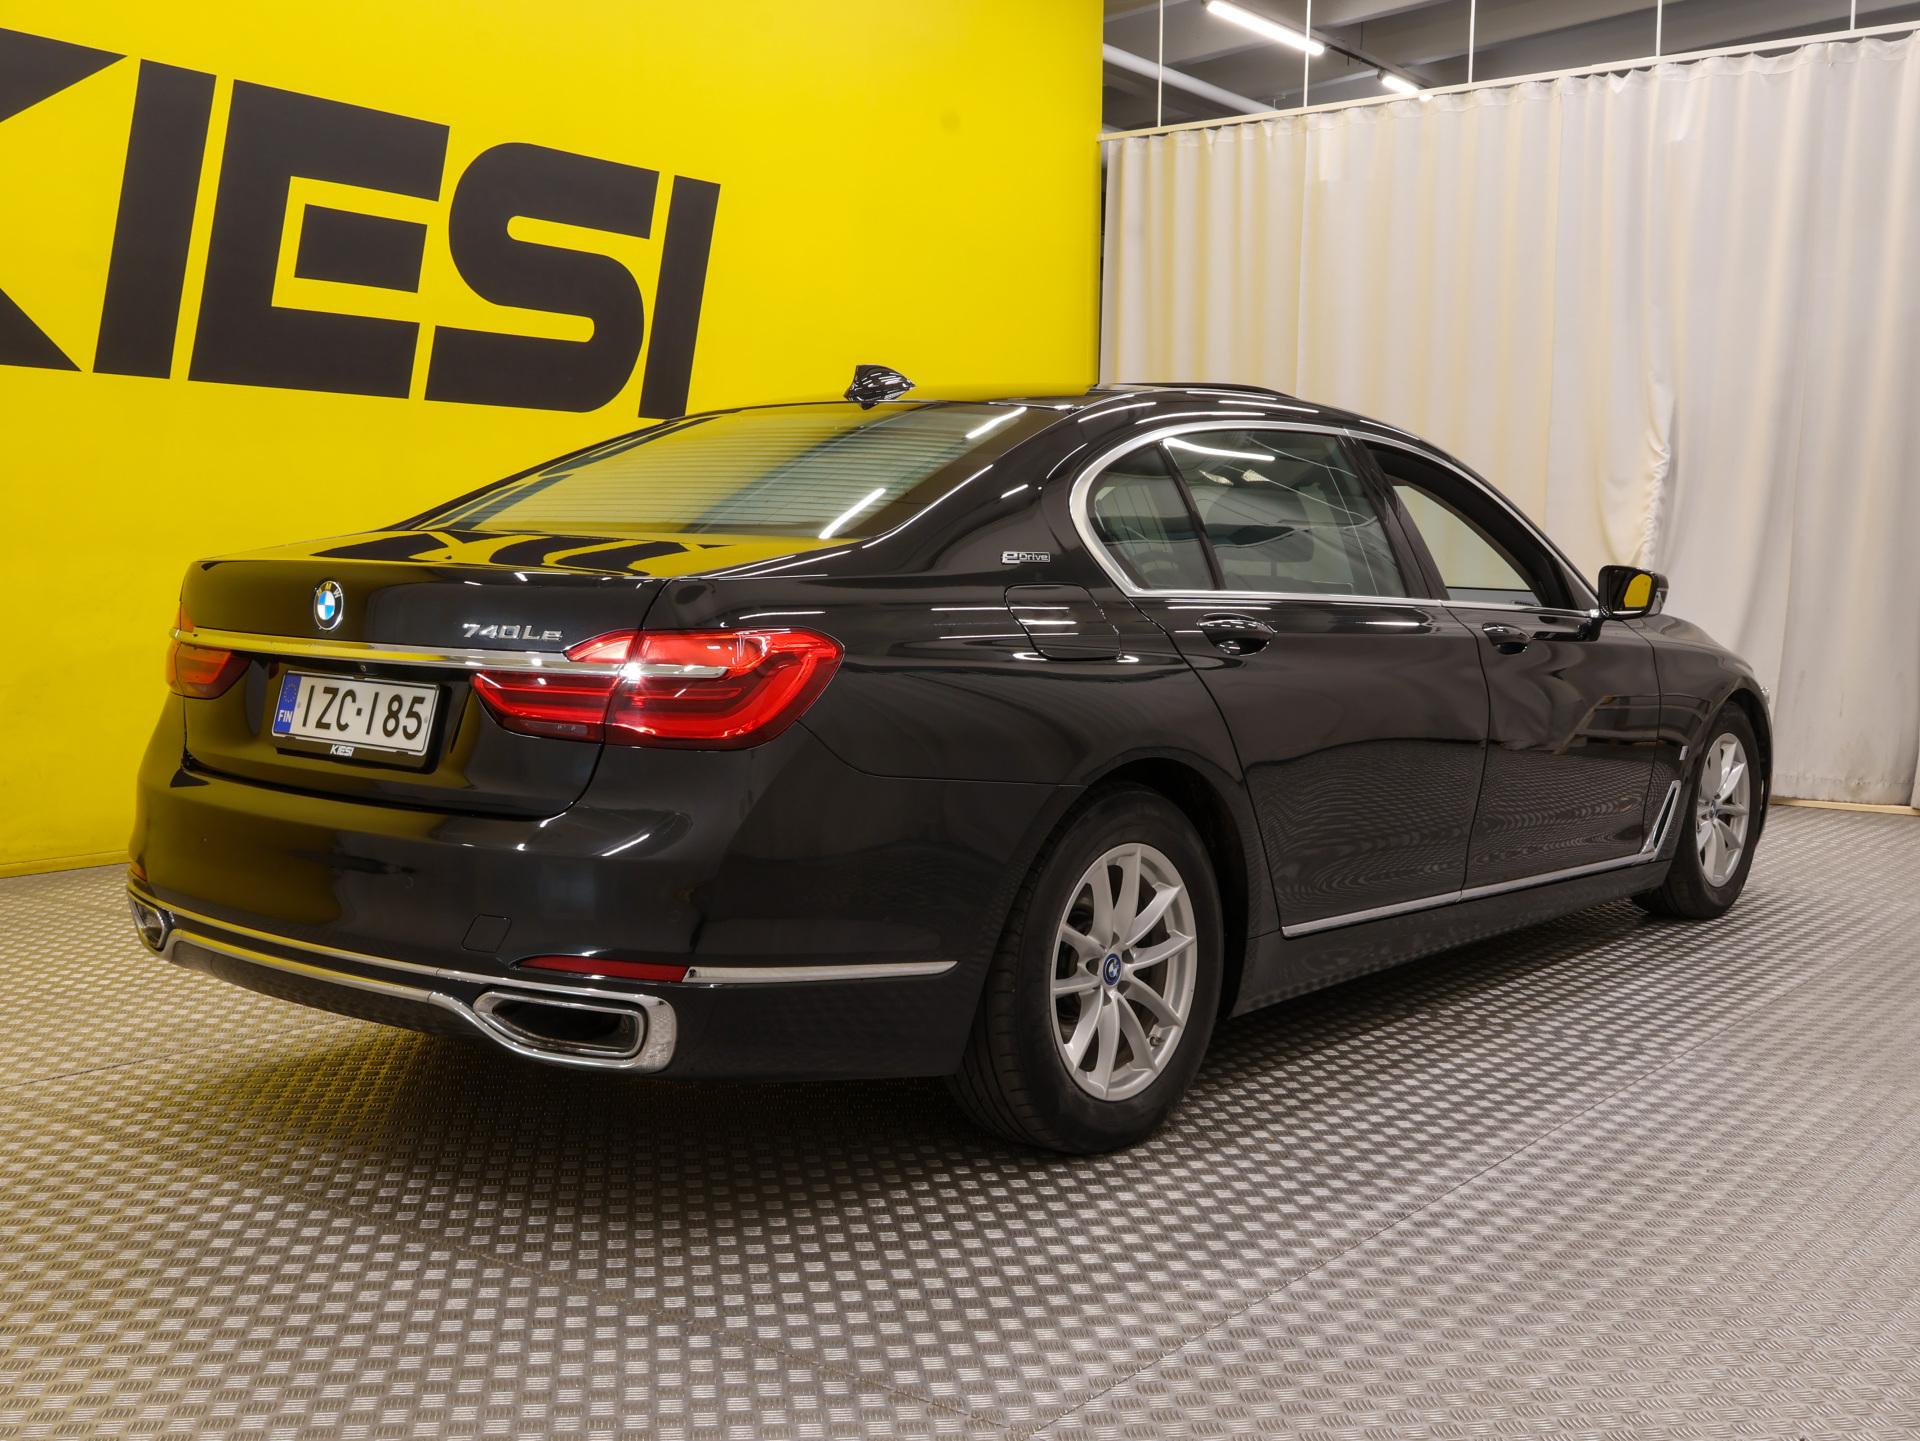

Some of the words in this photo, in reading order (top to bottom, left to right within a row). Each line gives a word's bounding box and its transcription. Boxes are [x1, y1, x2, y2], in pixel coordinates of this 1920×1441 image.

[1002, 551, 1050, 564] eDrive
[462, 623, 563, 641] 740Le
[277, 709, 293, 723] FIN
[302, 684, 426, 741] IZC-185
[330, 744, 354, 757] KIESI
